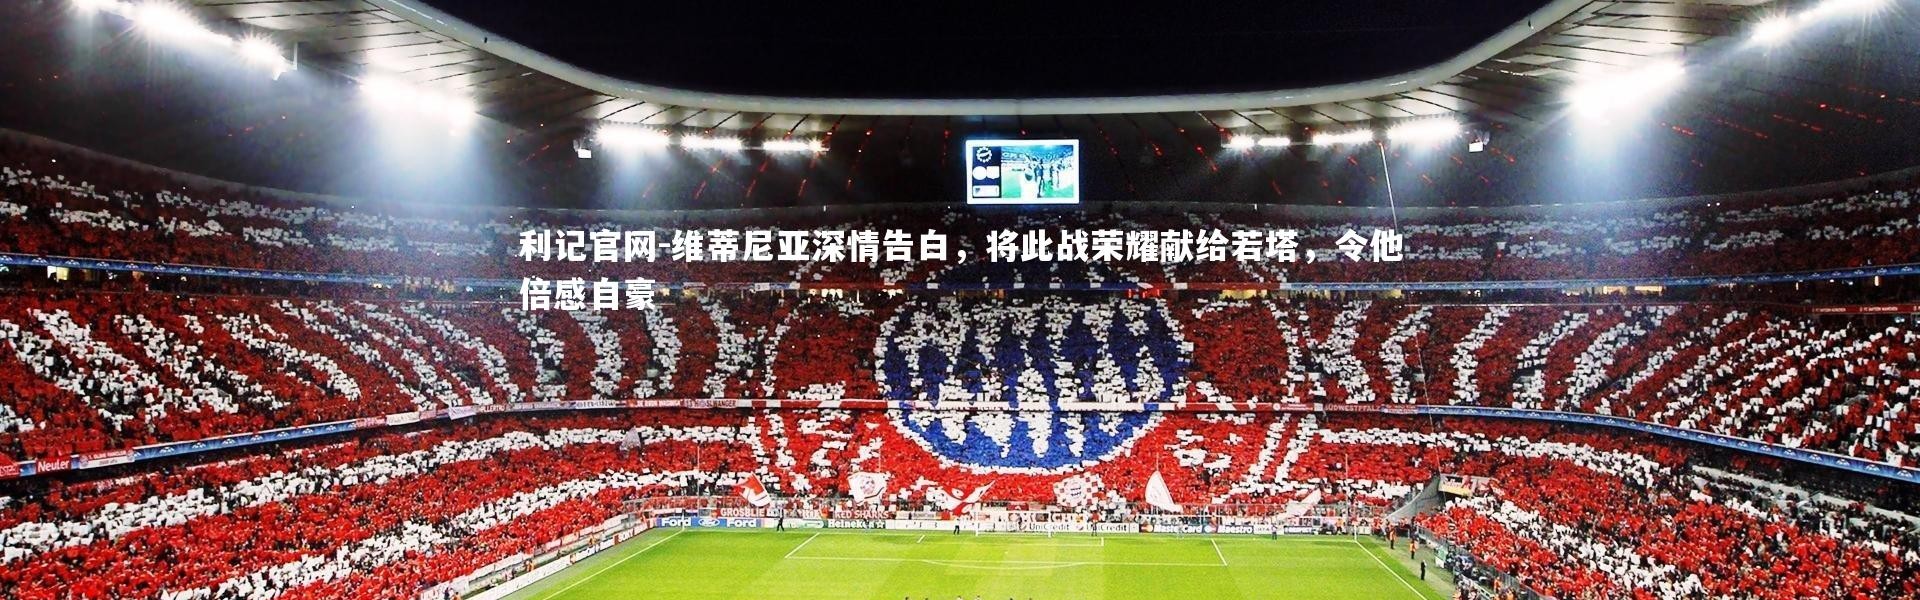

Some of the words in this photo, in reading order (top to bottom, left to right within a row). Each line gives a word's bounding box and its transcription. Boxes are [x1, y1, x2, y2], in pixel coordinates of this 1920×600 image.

[37, 460, 70, 472] Neuler
[661, 517, 692, 527] Ford
[727, 518, 757, 528] Ford
